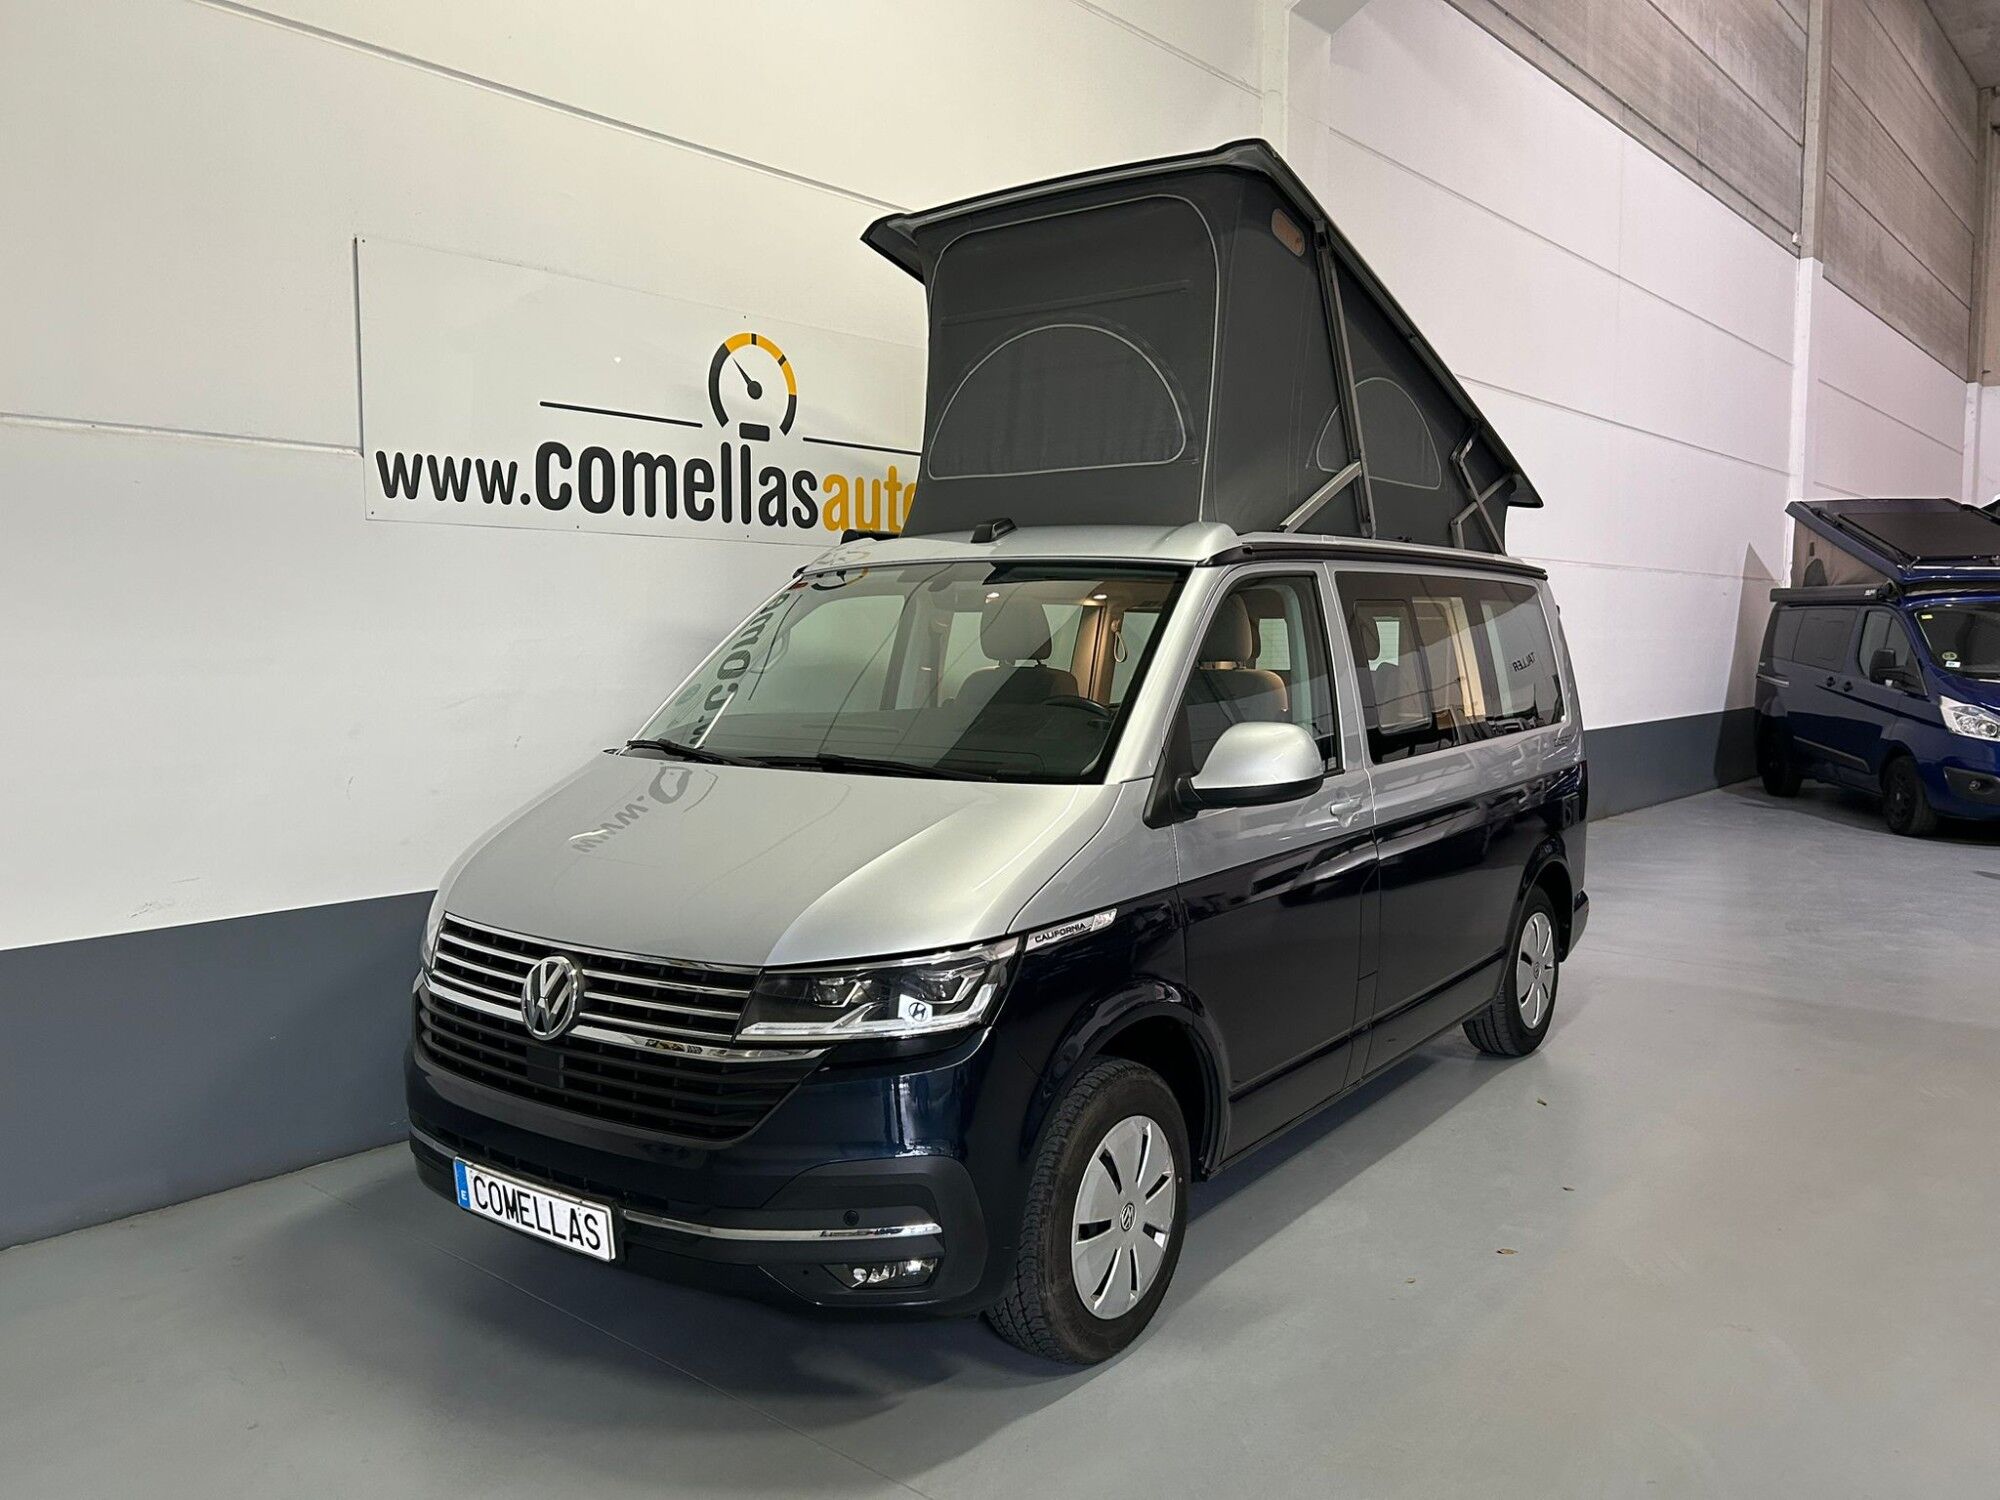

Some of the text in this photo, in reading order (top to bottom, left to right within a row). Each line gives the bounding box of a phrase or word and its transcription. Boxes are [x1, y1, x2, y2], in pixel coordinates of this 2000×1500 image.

[1034, 922, 1086, 943] CALIFORNIA
[461, 1189, 467, 1201] E
[473, 1175, 601, 1251] COMELLAS
